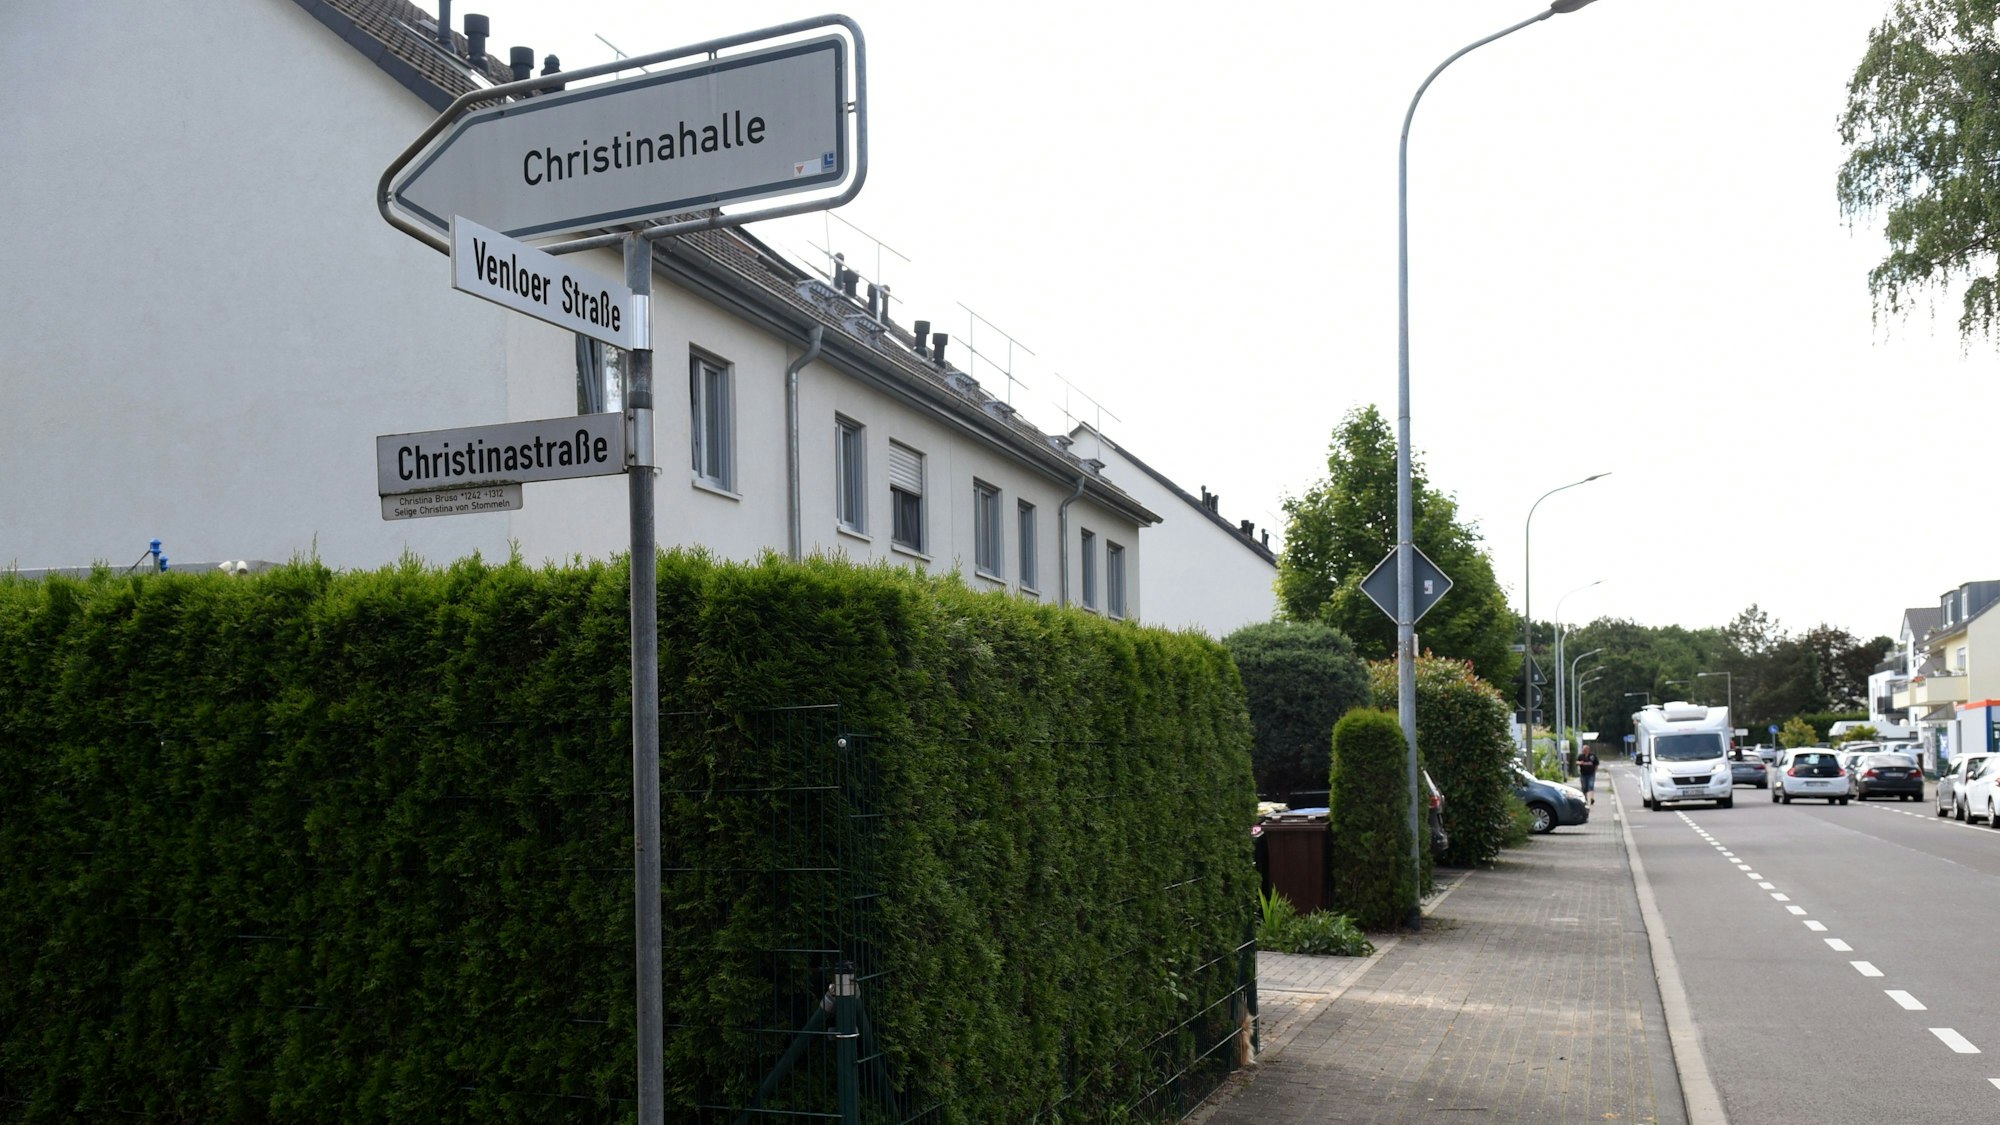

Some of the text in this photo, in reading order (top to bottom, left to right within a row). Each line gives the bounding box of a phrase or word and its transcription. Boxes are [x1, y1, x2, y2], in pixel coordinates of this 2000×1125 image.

[523, 110, 766, 186] Christinahalle
[473, 237, 621, 332] Venloer Straße
[398, 428, 608, 481] Christinastraße
[394, 500, 510, 518] Selige Christina von Stommeln
[399, 495, 433, 506] Christina
[435, 494, 458, 503] Bruso
